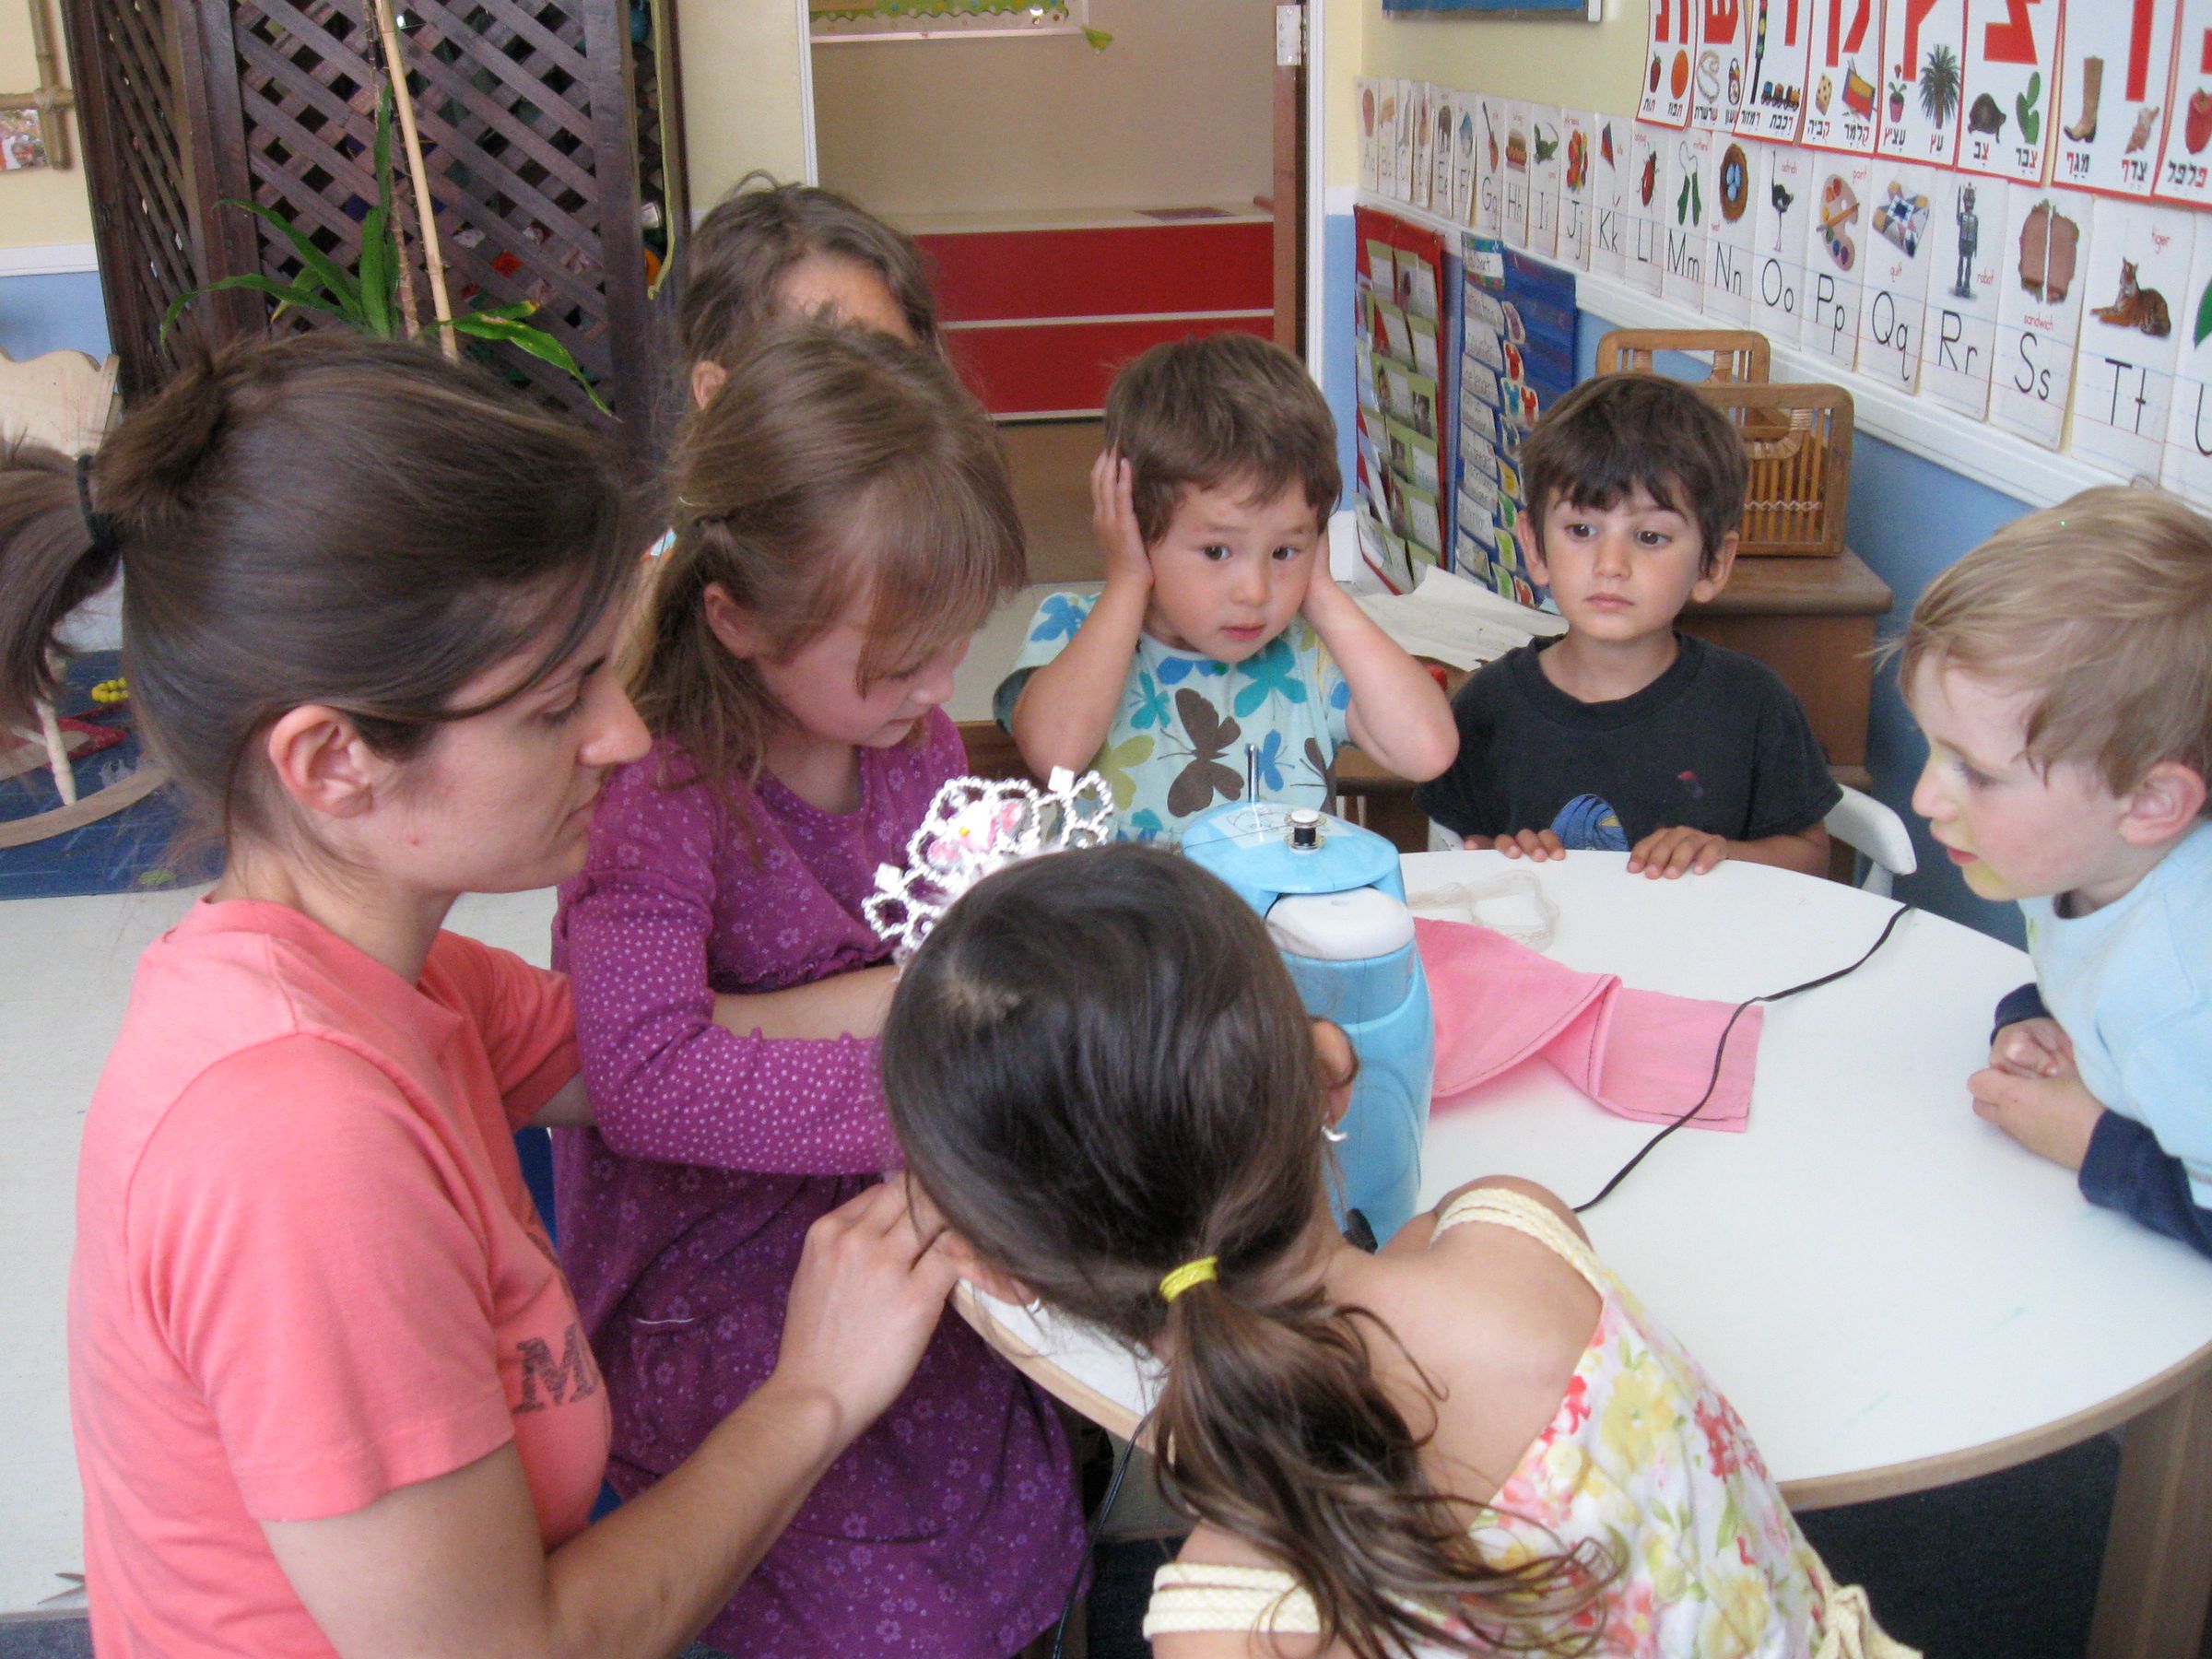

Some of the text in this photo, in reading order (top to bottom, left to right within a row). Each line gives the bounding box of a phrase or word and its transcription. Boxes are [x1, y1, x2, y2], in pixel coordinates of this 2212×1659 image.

[1481, 176, 1498, 230] Gg
[1508, 182, 1523, 222] Hh
[1539, 192, 1549, 229] Ii
[1567, 200, 1583, 260] Jj
[1599, 208, 1618, 253] Kk
[1637, 218, 1654, 264] Ll
[1667, 229, 1700, 284] Mm
[1714, 241, 1742, 296] Nn
[1761, 258, 1794, 312] Oo
[1816, 274, 1845, 356] Pp
[1872, 290, 1910, 381] Qq
[1939, 310, 1978, 374] Rr
[2015, 332, 2051, 401] Ss
[2105, 358, 2147, 434] Tt
